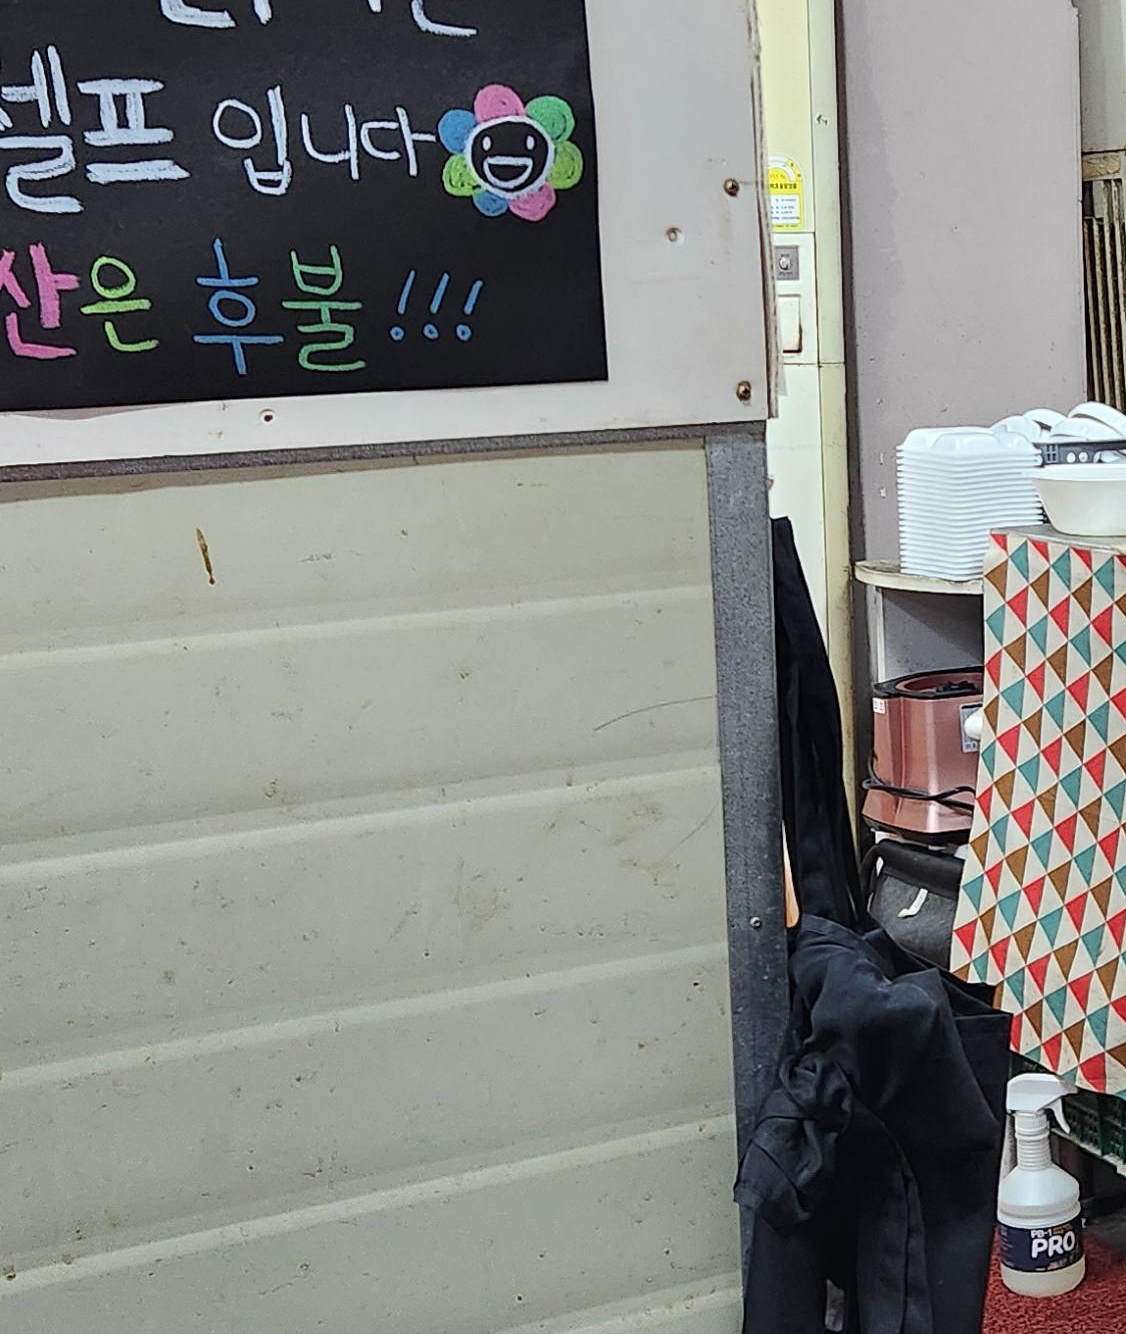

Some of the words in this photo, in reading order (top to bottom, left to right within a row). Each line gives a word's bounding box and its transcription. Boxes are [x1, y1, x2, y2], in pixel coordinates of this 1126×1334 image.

[0, 45, 192, 214] 셀프
[211, 84, 437, 197] 입니다
[0, 242, 160, 360] 산은
[193, 238, 367, 375] 후불
[1030, 1230, 1076, 1259] PRO
